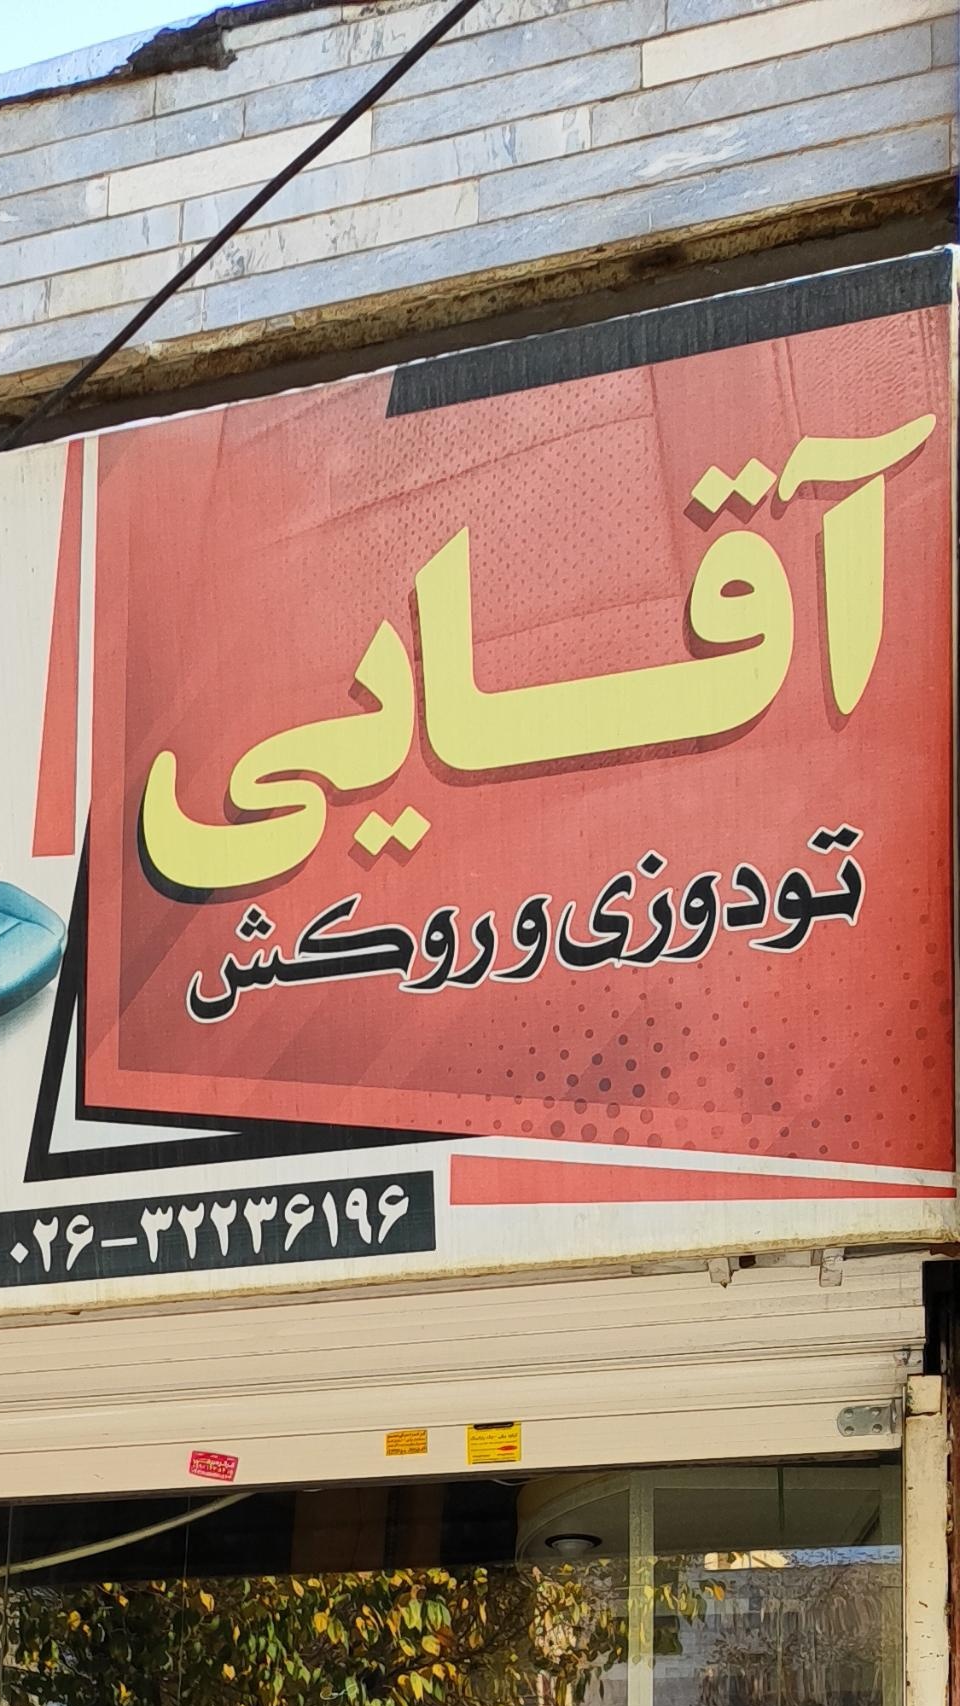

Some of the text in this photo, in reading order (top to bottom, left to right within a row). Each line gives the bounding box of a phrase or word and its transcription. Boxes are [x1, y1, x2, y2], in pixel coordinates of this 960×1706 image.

[141, 413, 938, 890] آقایی
[185, 824, 866, 1024] تودوزی و روکش
[9, 1183, 410, 1274] ۰۲۶-۳۲۲۳۶۱۹۶
